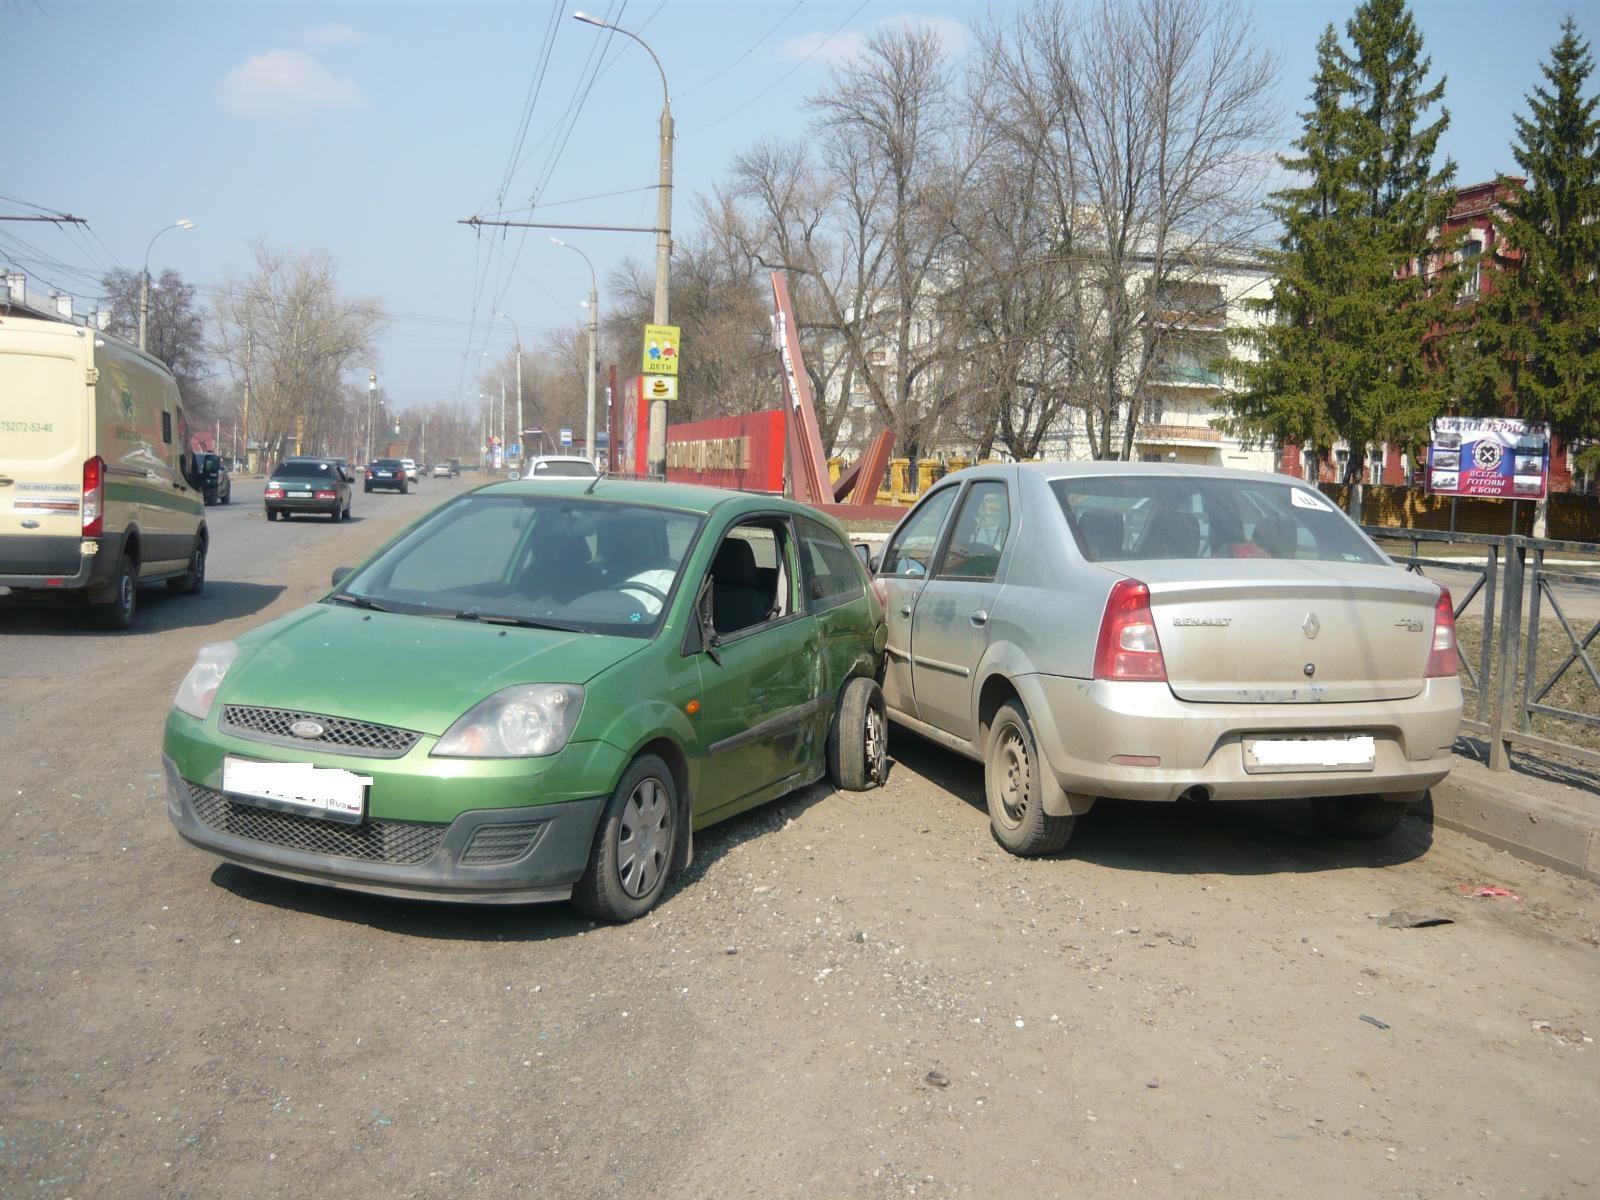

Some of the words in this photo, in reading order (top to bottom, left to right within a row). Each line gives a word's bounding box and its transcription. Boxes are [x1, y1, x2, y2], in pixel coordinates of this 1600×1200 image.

[650, 363, 672, 371] ДЕТИ
[1470, 470, 1503, 479] ВСЕГДА
[1466, 478, 1506, 486] ГОТОВЫ
[1478, 486, 1501, 494] БОЮ
[1172, 616, 1232, 626] RENAULT
